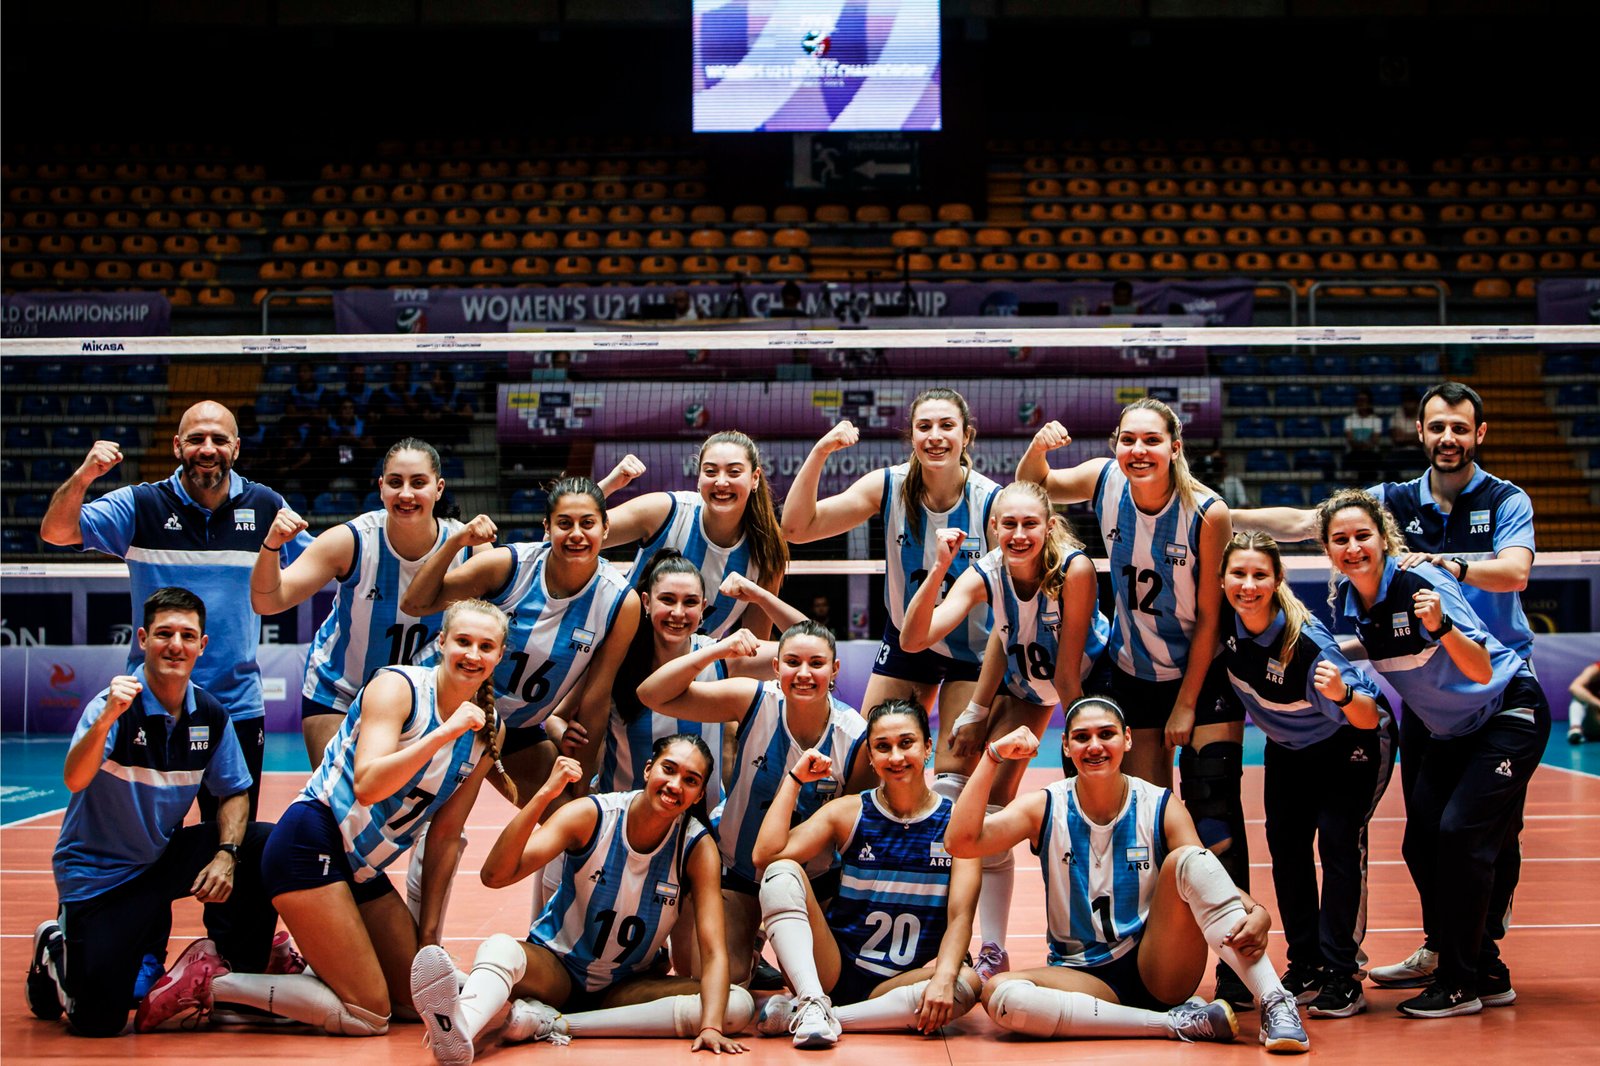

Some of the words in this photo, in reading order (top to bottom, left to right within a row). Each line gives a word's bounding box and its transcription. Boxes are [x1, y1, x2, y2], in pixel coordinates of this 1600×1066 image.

[24, 304, 149, 322] CHAMPIONSHIP
[461, 293, 586, 321] WOMEN'S
[593, 293, 640, 320] U21
[235, 522, 256, 531] ARG
[1470, 524, 1490, 534] ARG
[960, 551, 980, 560] ARG
[1164, 557, 1186, 567] ARG
[1122, 563, 1163, 617] 12
[1393, 627, 1411, 638] ARG
[384, 623, 429, 666] 10
[568, 642, 591, 654] ARG
[876, 641, 891, 666] 13
[1008, 642, 1055, 682] 18
[507, 651, 556, 704] 16
[1265, 671, 1284, 686] ARG
[190, 741, 209, 751] ARG
[387, 786, 435, 832] 7
[319, 853, 331, 876] 7
[929, 857, 952, 867] ARG
[1127, 862, 1151, 872] ARG
[653, 895, 676, 907] ARG
[1091, 895, 1116, 943] 1
[593, 908, 647, 964] 19
[860, 911, 921, 966] 20
